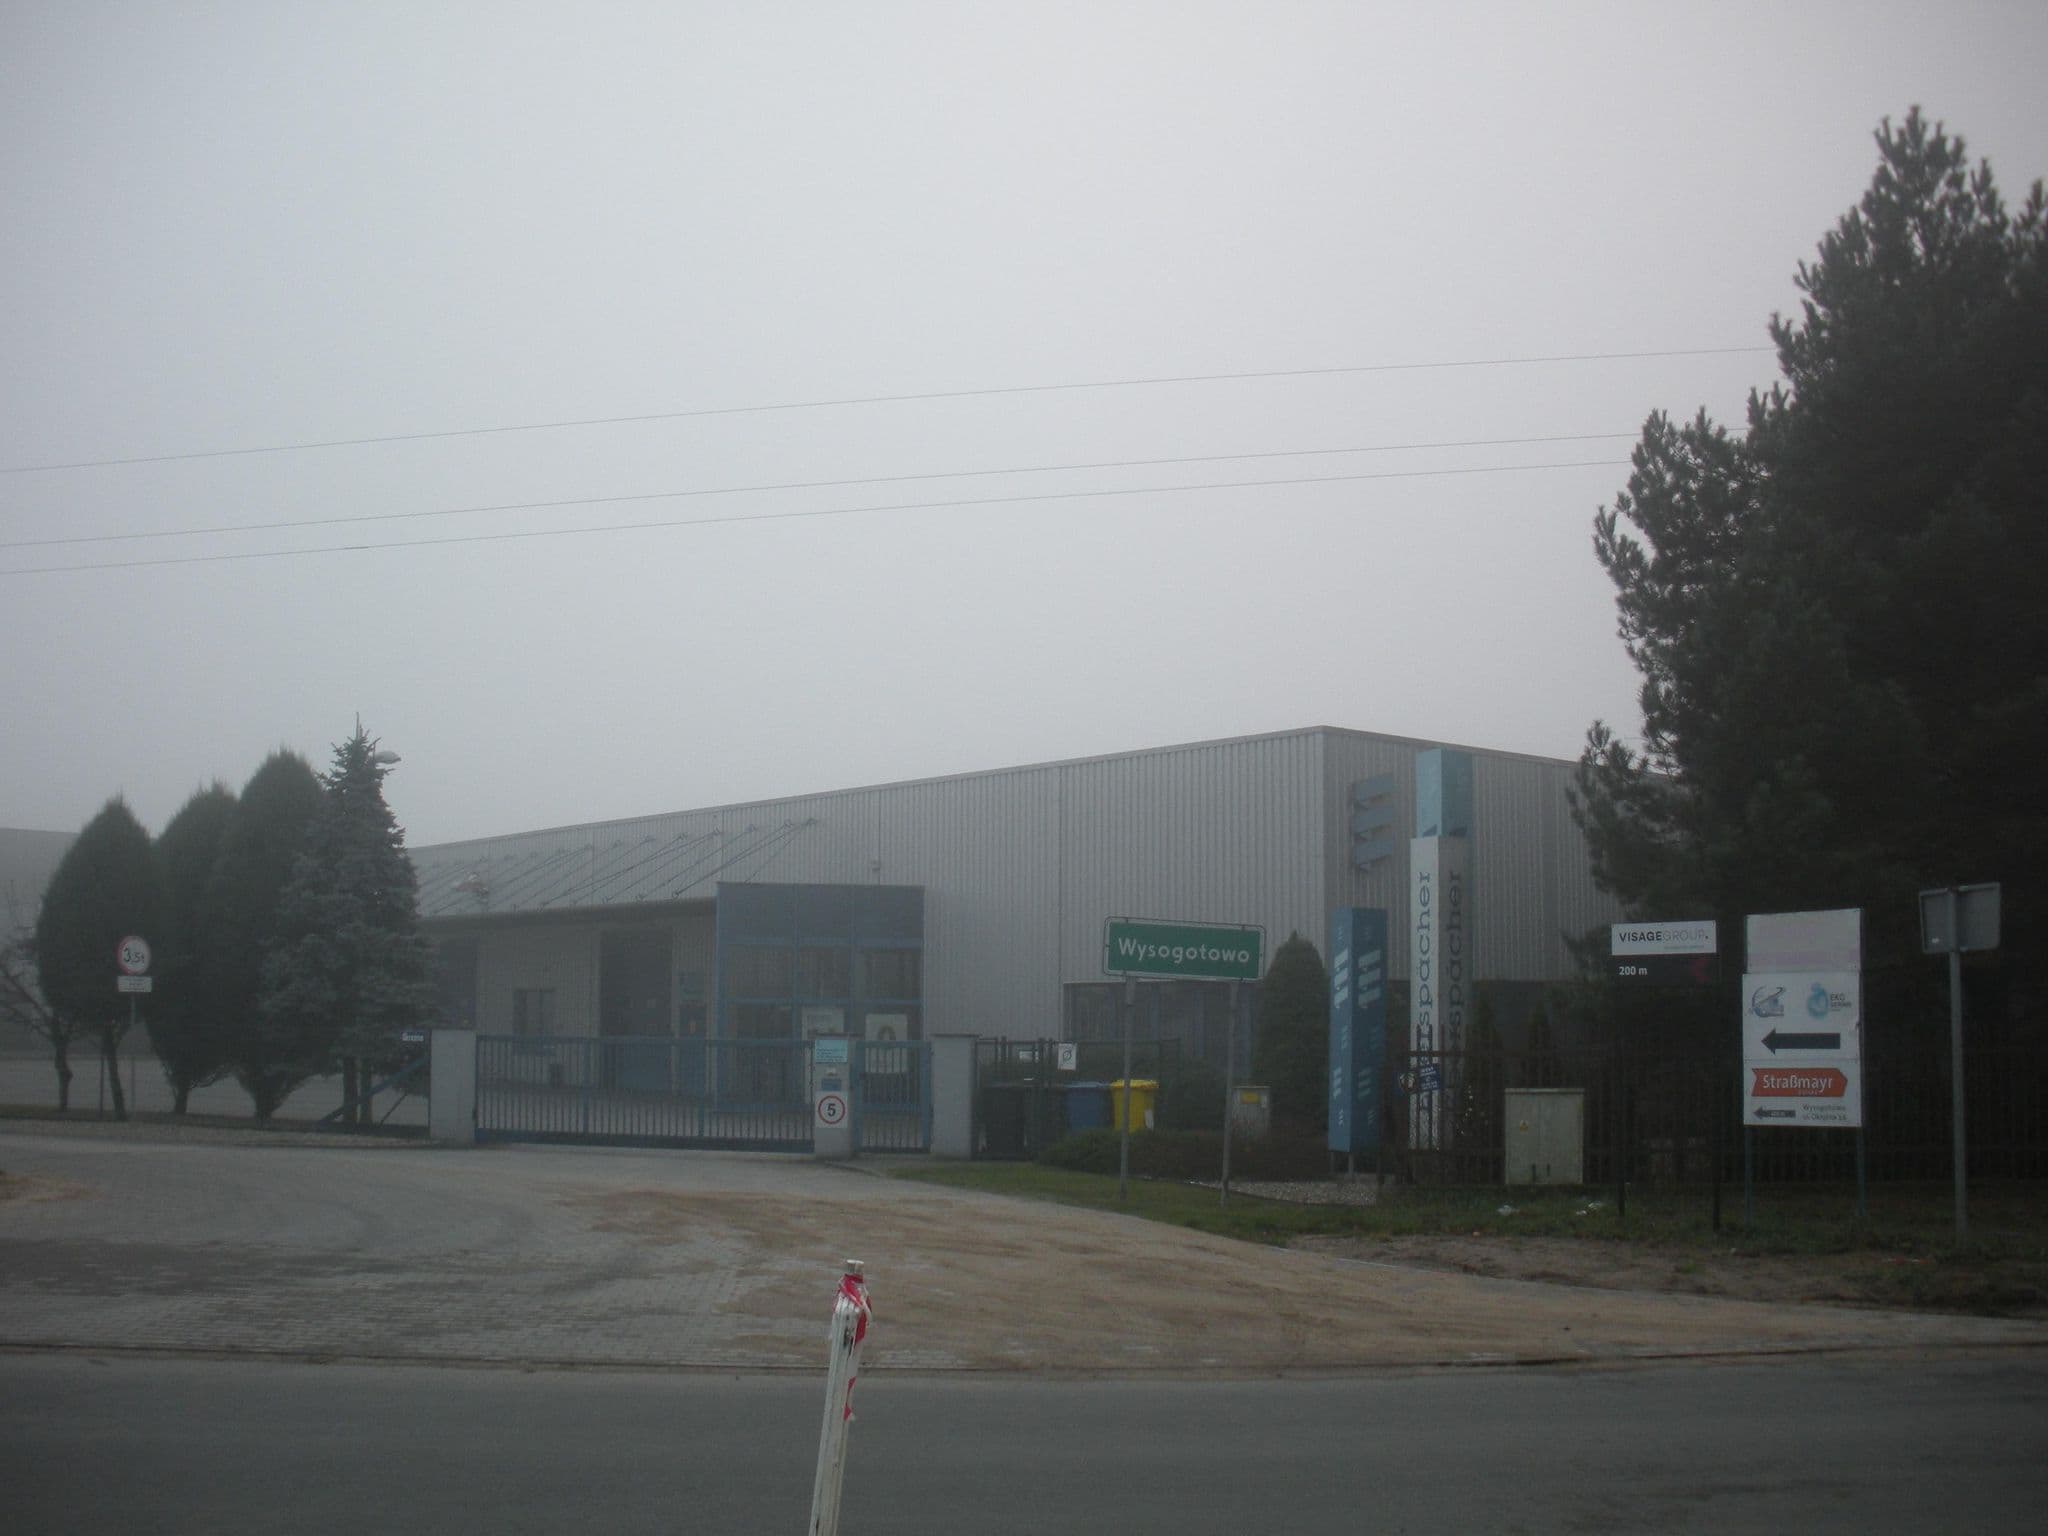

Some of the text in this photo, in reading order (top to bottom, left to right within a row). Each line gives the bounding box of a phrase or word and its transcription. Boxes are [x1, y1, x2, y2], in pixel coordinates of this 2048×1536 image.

[1118, 937, 1250, 964] Wysogotowo
[1618, 966, 1648, 976] 200 m
[1763, 1074, 1833, 1093] Straßmayr
[827, 1103, 836, 1117] 5
